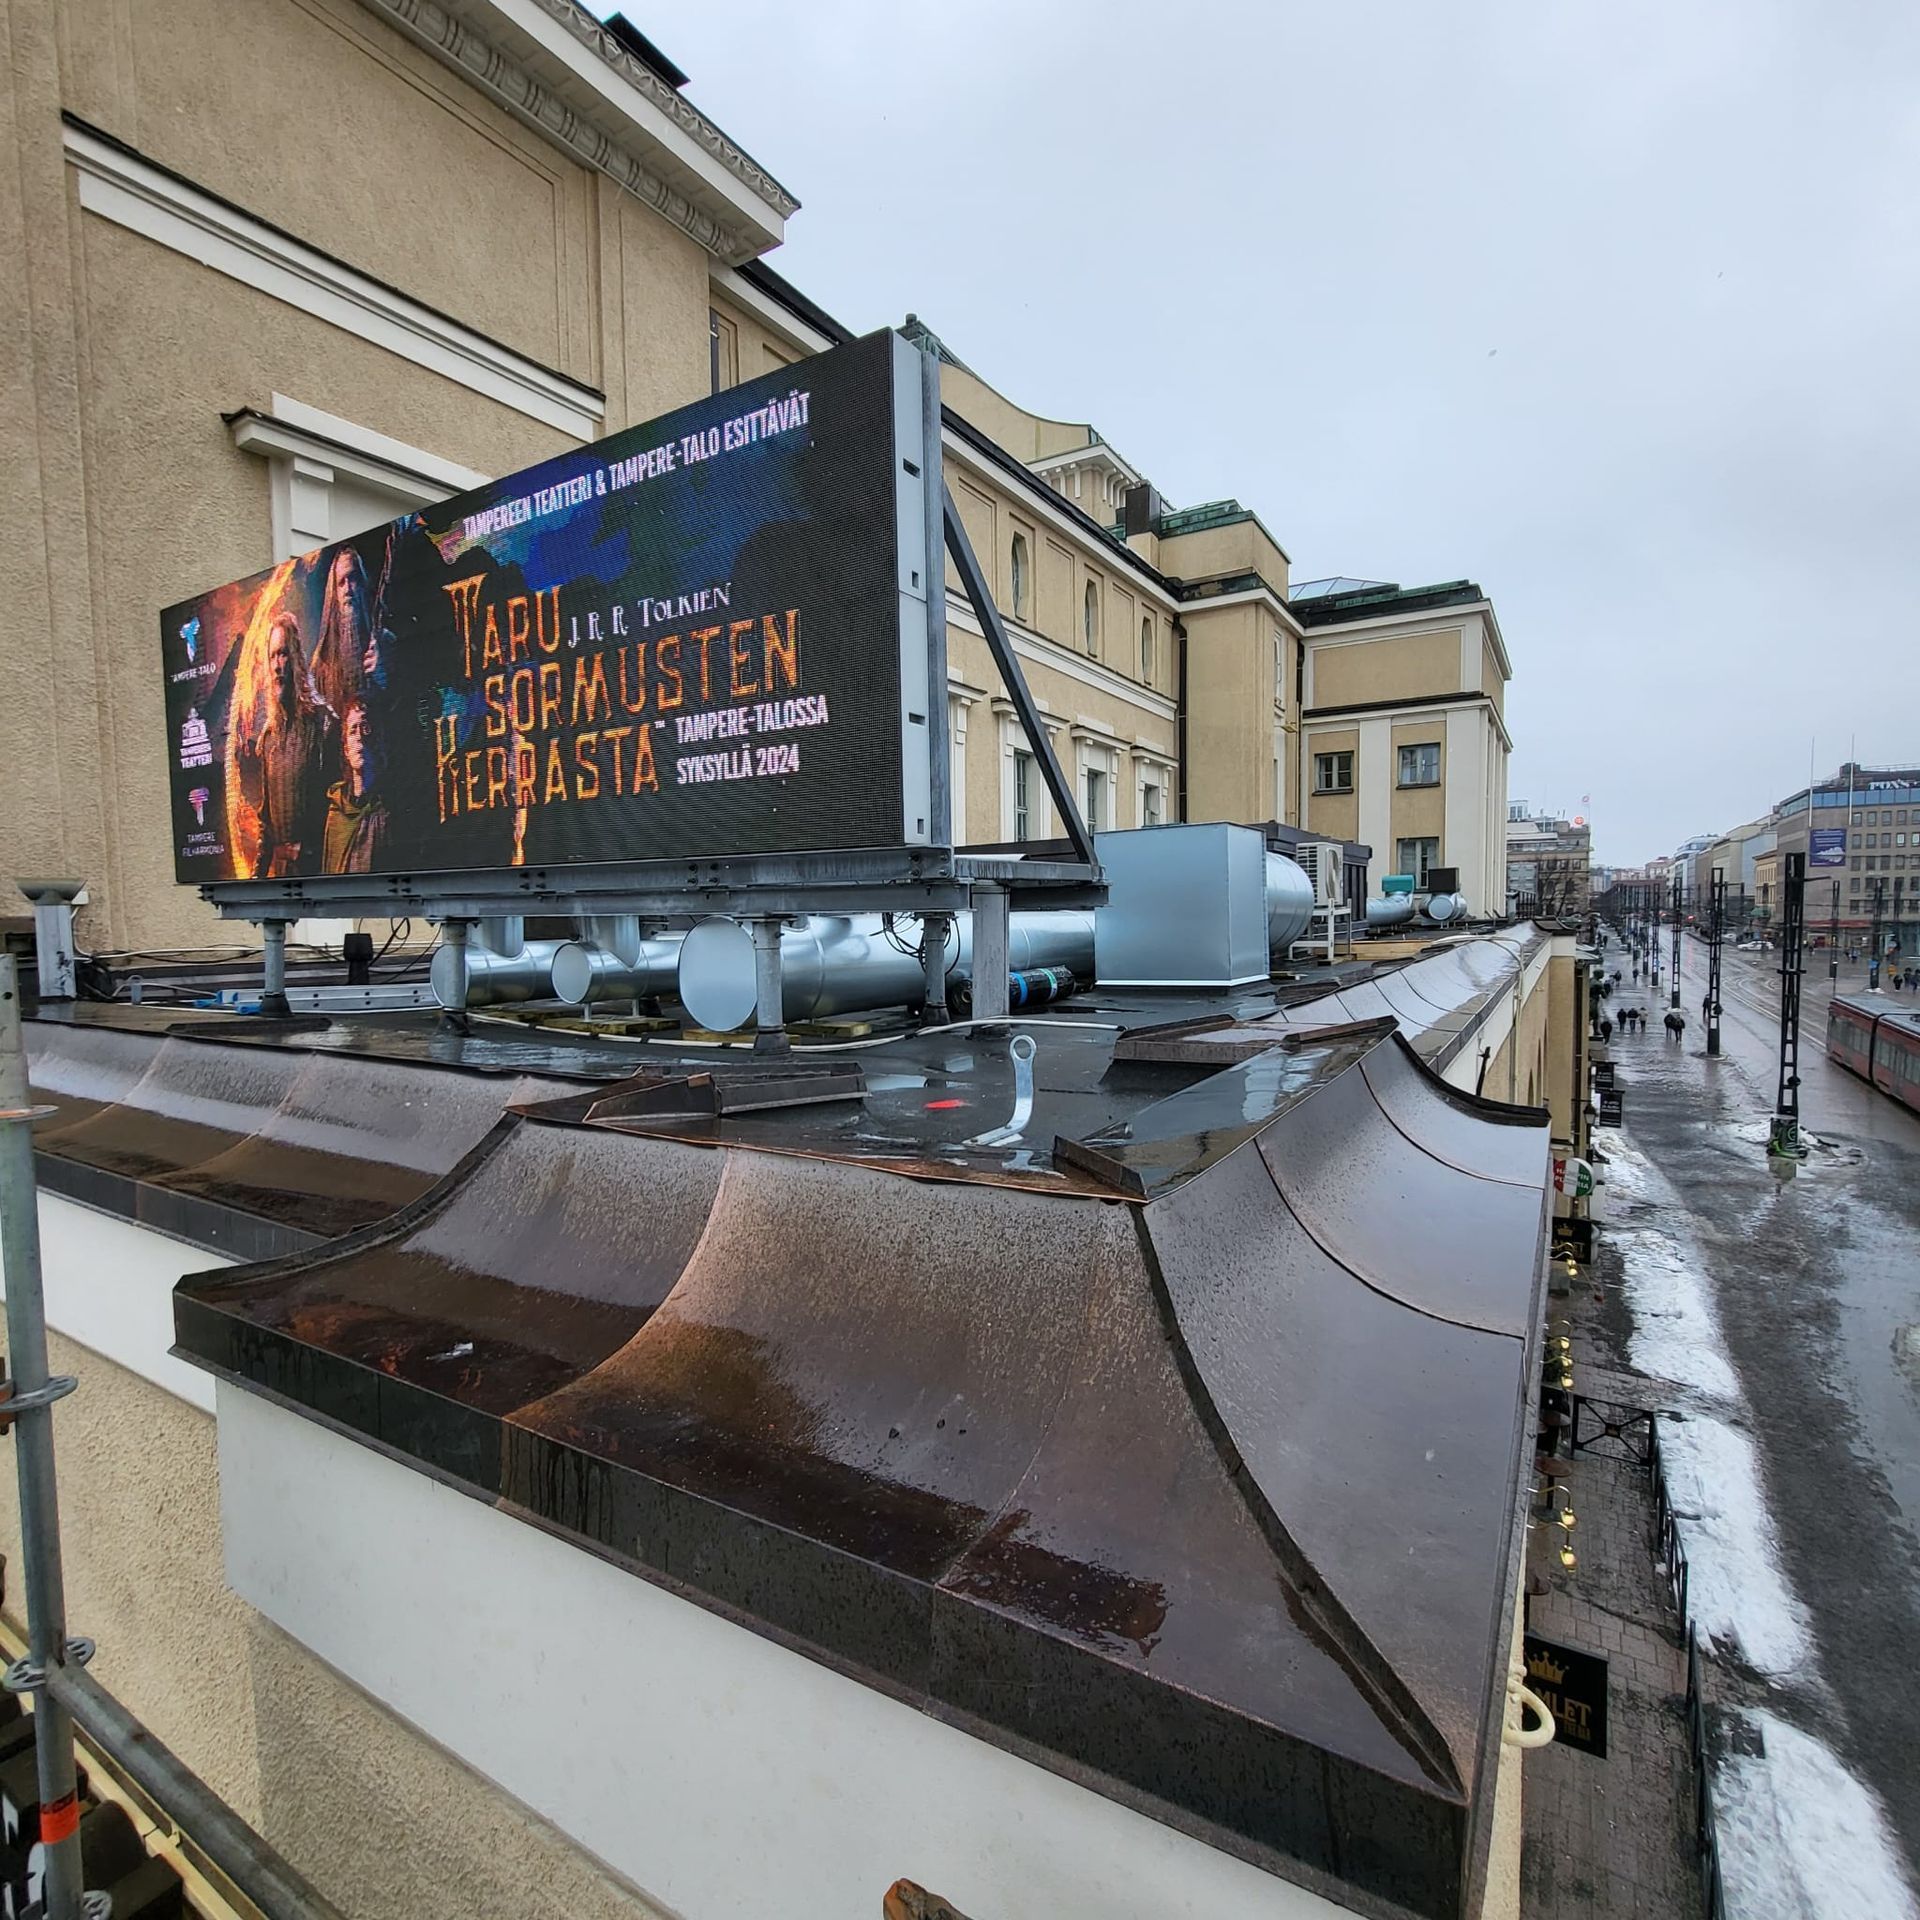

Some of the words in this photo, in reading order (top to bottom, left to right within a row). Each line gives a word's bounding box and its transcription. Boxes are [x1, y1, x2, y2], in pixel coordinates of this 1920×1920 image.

[463, 495, 532, 540] TAMPEREEN
[533, 473, 592, 517] TEATTERI
[595, 469, 607, 496] &
[609, 427, 720, 490] TAMPERE-TALO
[723, 388, 810, 451] ESITTÄVÄT
[442, 572, 562, 679] TARU
[637, 582, 732, 627] TOLKIEN
[484, 609, 800, 738] SORMUSTEN
[675, 694, 829, 743] TAMPERE-TALOSSA
[676, 744, 754, 786] SYKSYLLÄ
[756, 744, 800, 774] 2024
[1534, 1687, 1593, 1727] MLET
